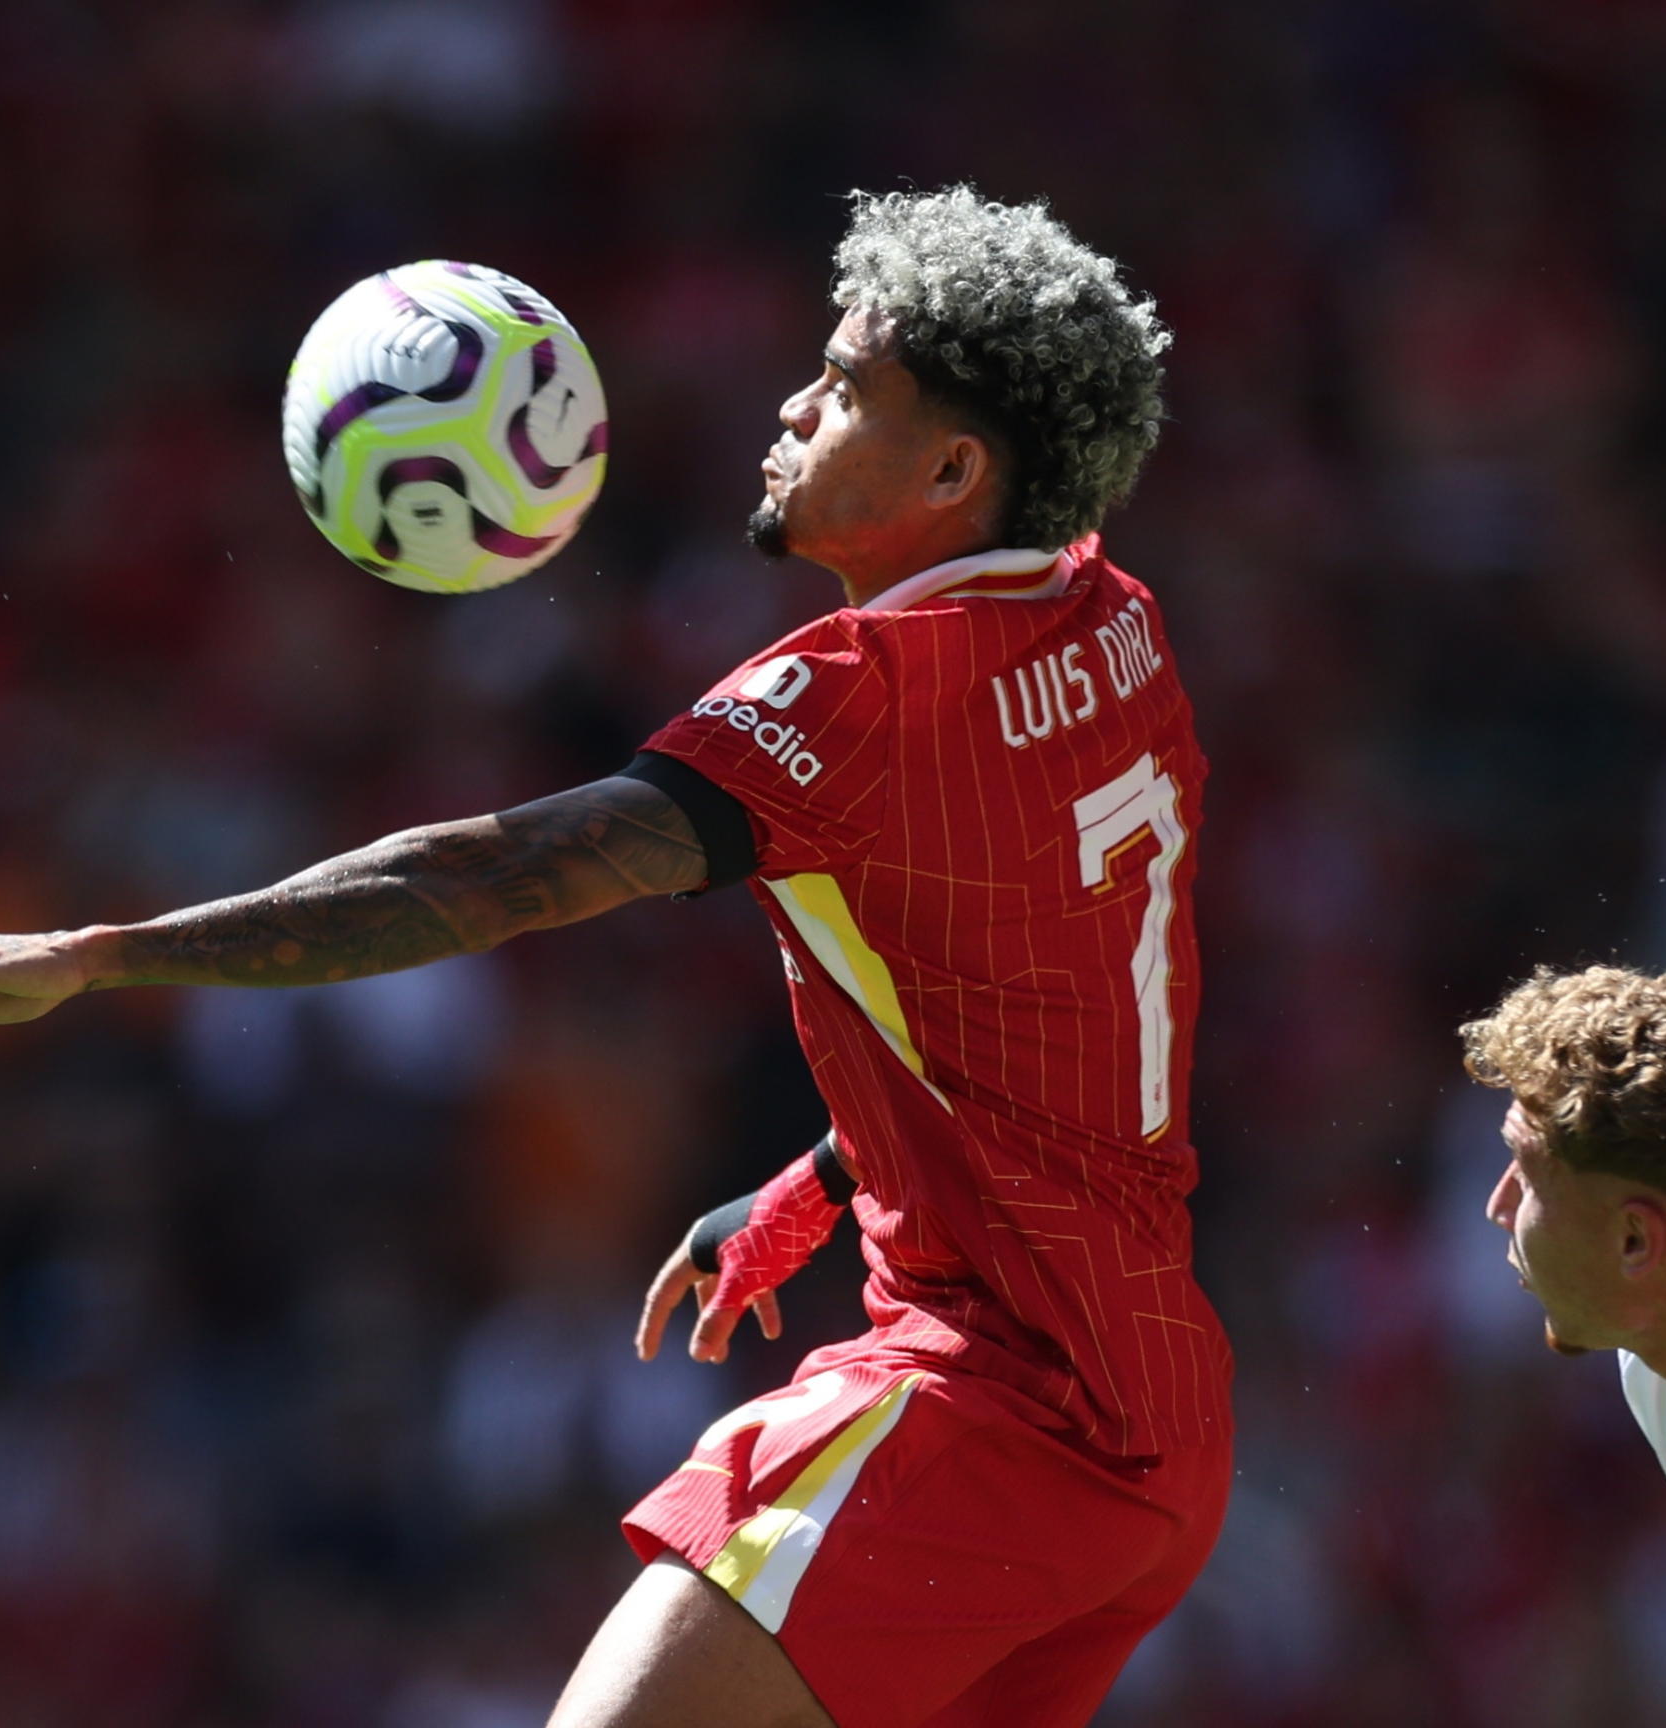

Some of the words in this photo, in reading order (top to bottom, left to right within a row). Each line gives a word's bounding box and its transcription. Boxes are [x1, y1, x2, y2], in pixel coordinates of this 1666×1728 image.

[691, 696, 823, 787] pedia
[991, 642, 1099, 750] LUIS
[1072, 751, 1190, 1145] 7
